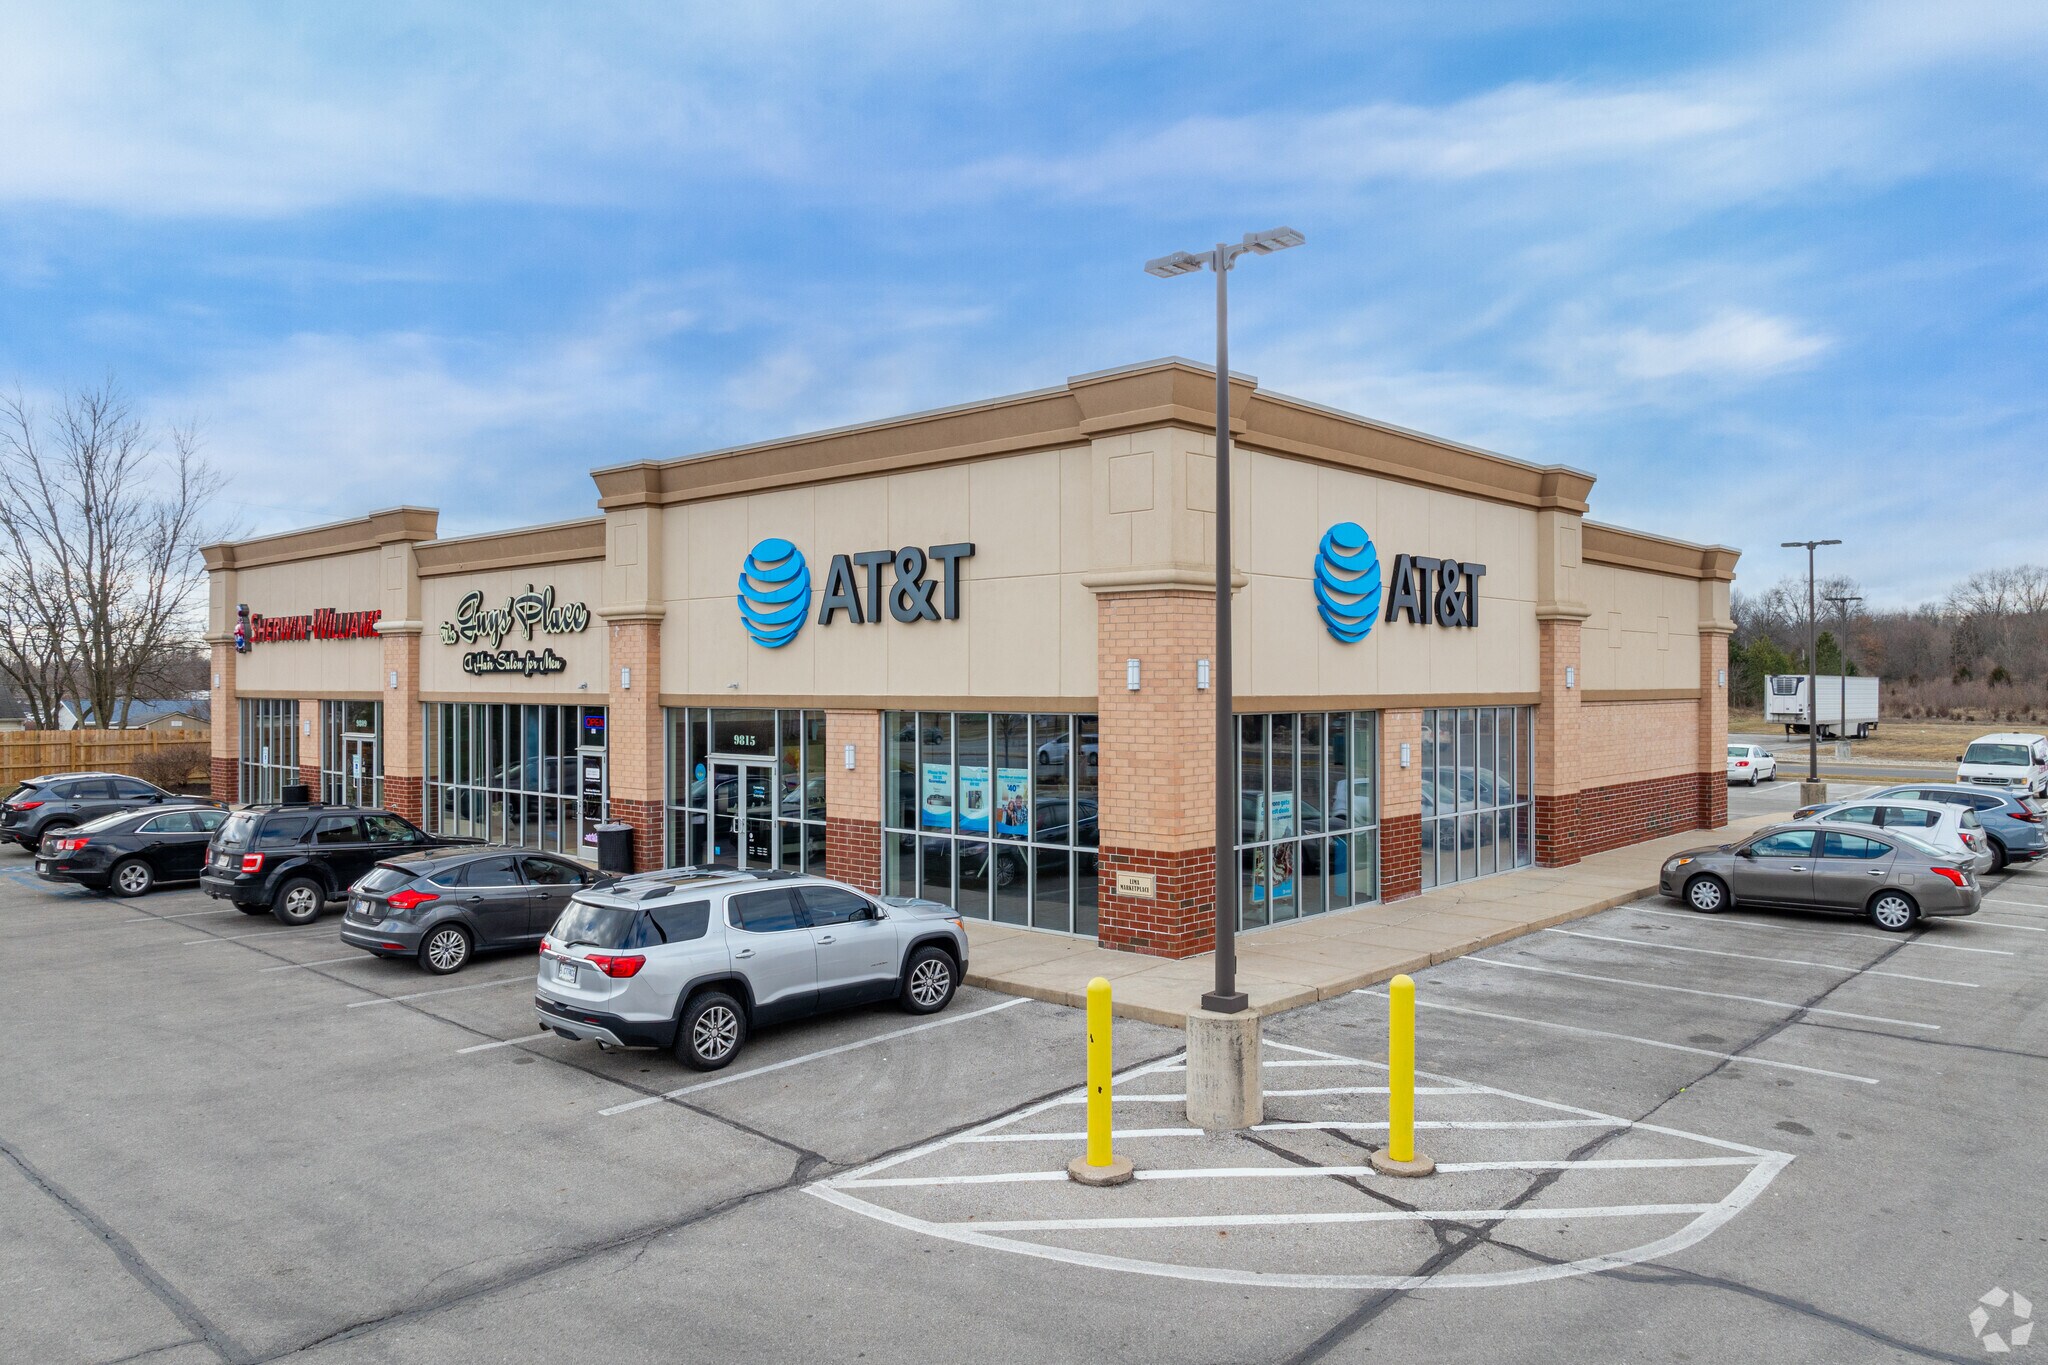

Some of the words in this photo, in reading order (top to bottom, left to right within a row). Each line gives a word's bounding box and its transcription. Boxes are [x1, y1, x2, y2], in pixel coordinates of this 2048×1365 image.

[818, 542, 976, 625] AT&T
[1384, 553, 1487, 628] AT&T
[439, 621, 459, 645] The
[513, 583, 591, 641] Place
[463, 653, 474, 671] A
[473, 653, 495, 673] Hair
[495, 653, 524, 671] Salon
[524, 654, 539, 675] for
[539, 650, 562, 672] Men
[586, 717, 605, 727] OPEN
[734, 734, 756, 747] 9815
[1120, 884, 1150, 894] MARKETPLACE
